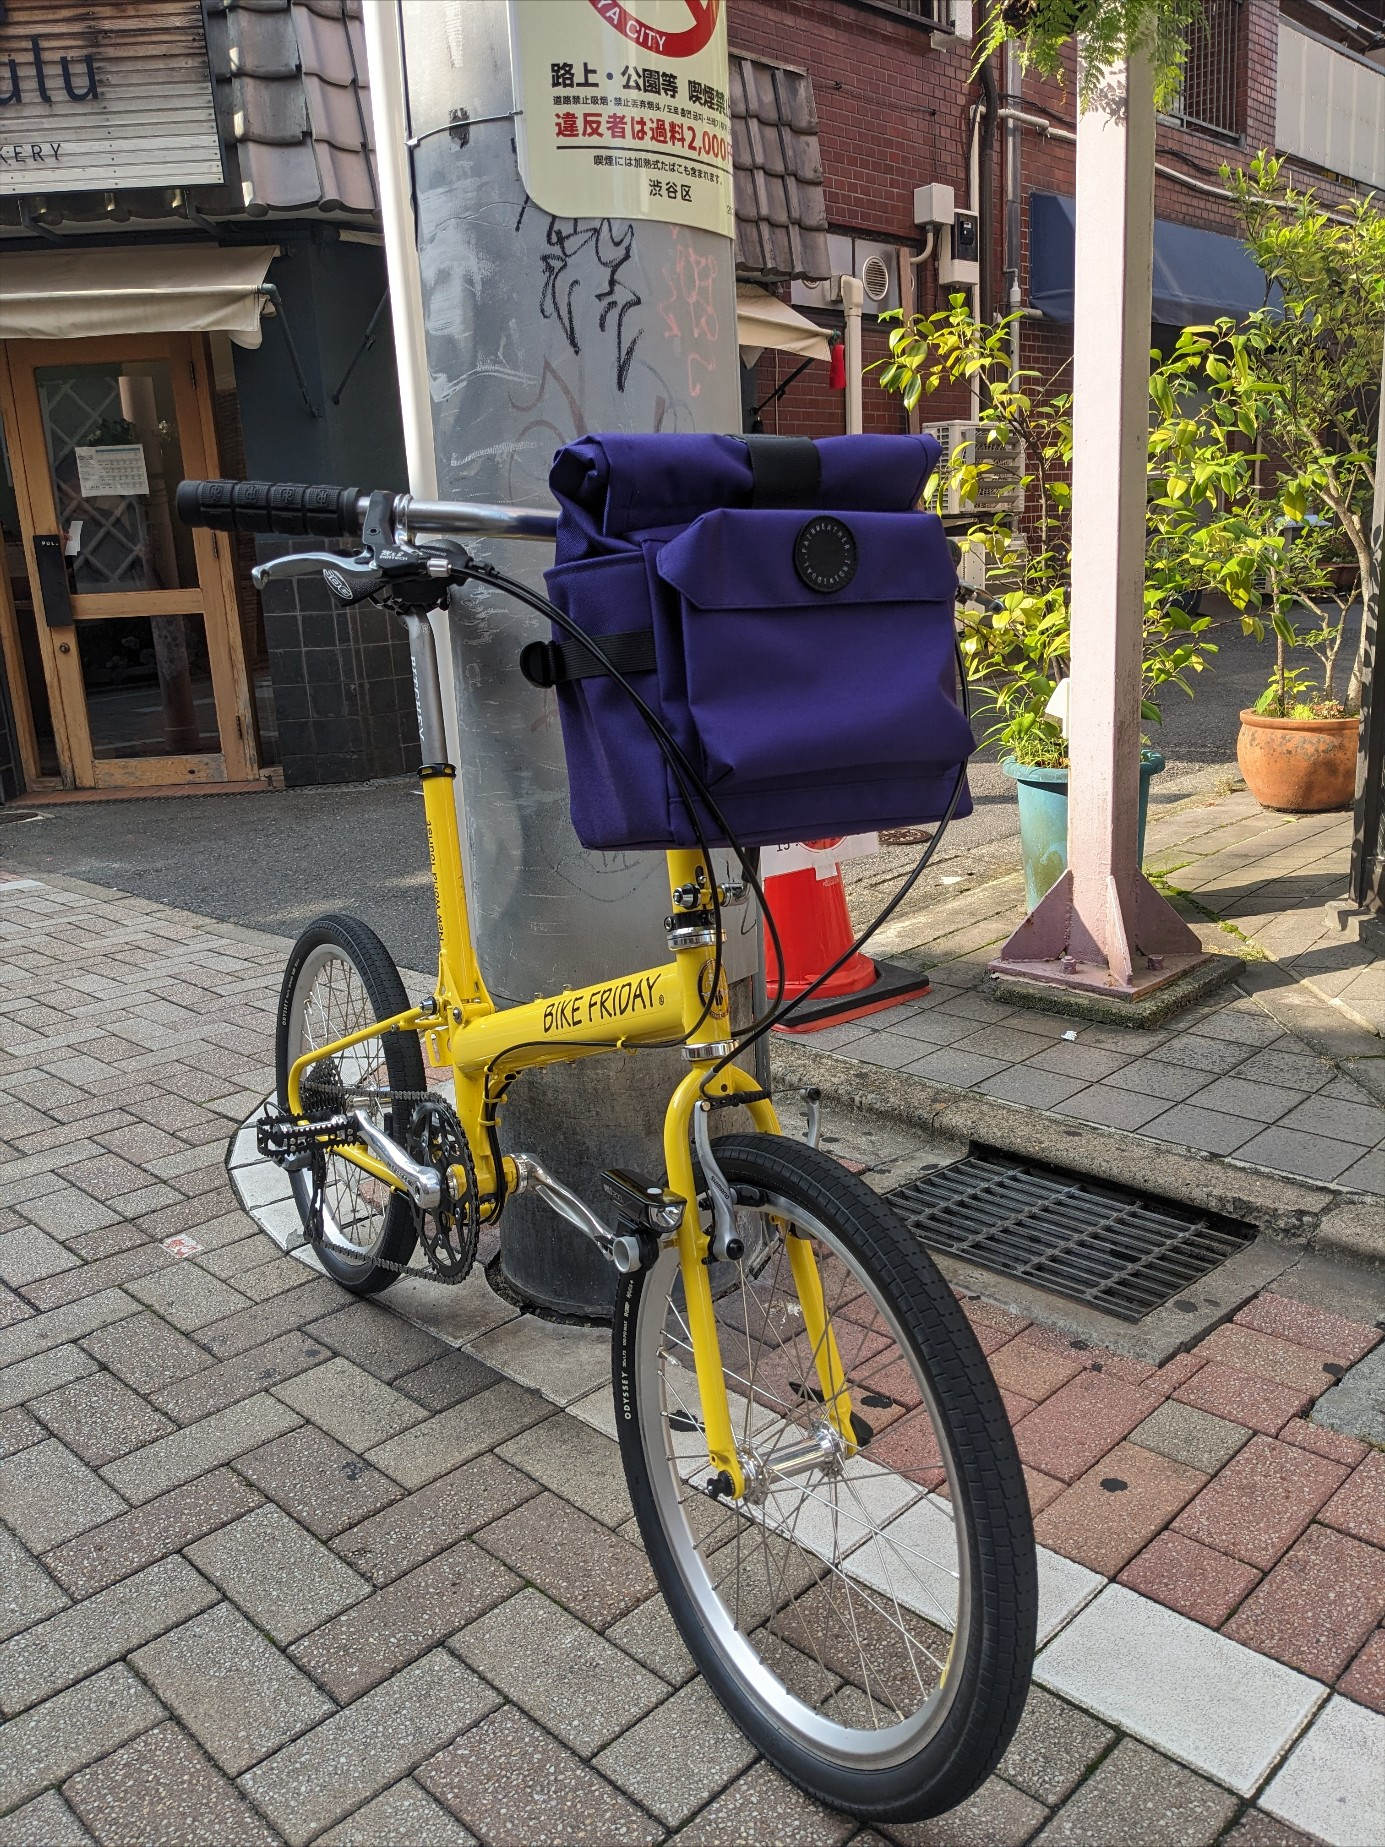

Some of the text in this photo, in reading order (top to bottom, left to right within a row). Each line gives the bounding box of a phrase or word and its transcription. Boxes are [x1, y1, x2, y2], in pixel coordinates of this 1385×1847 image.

[626, 20, 666, 51] CITY
[648, 178, 693, 203] 渋谷区
[543, 995, 584, 1034] BIKE
[587, 973, 662, 1023] FRIDAY
[620, 1371, 632, 1420] ODYSSEY
